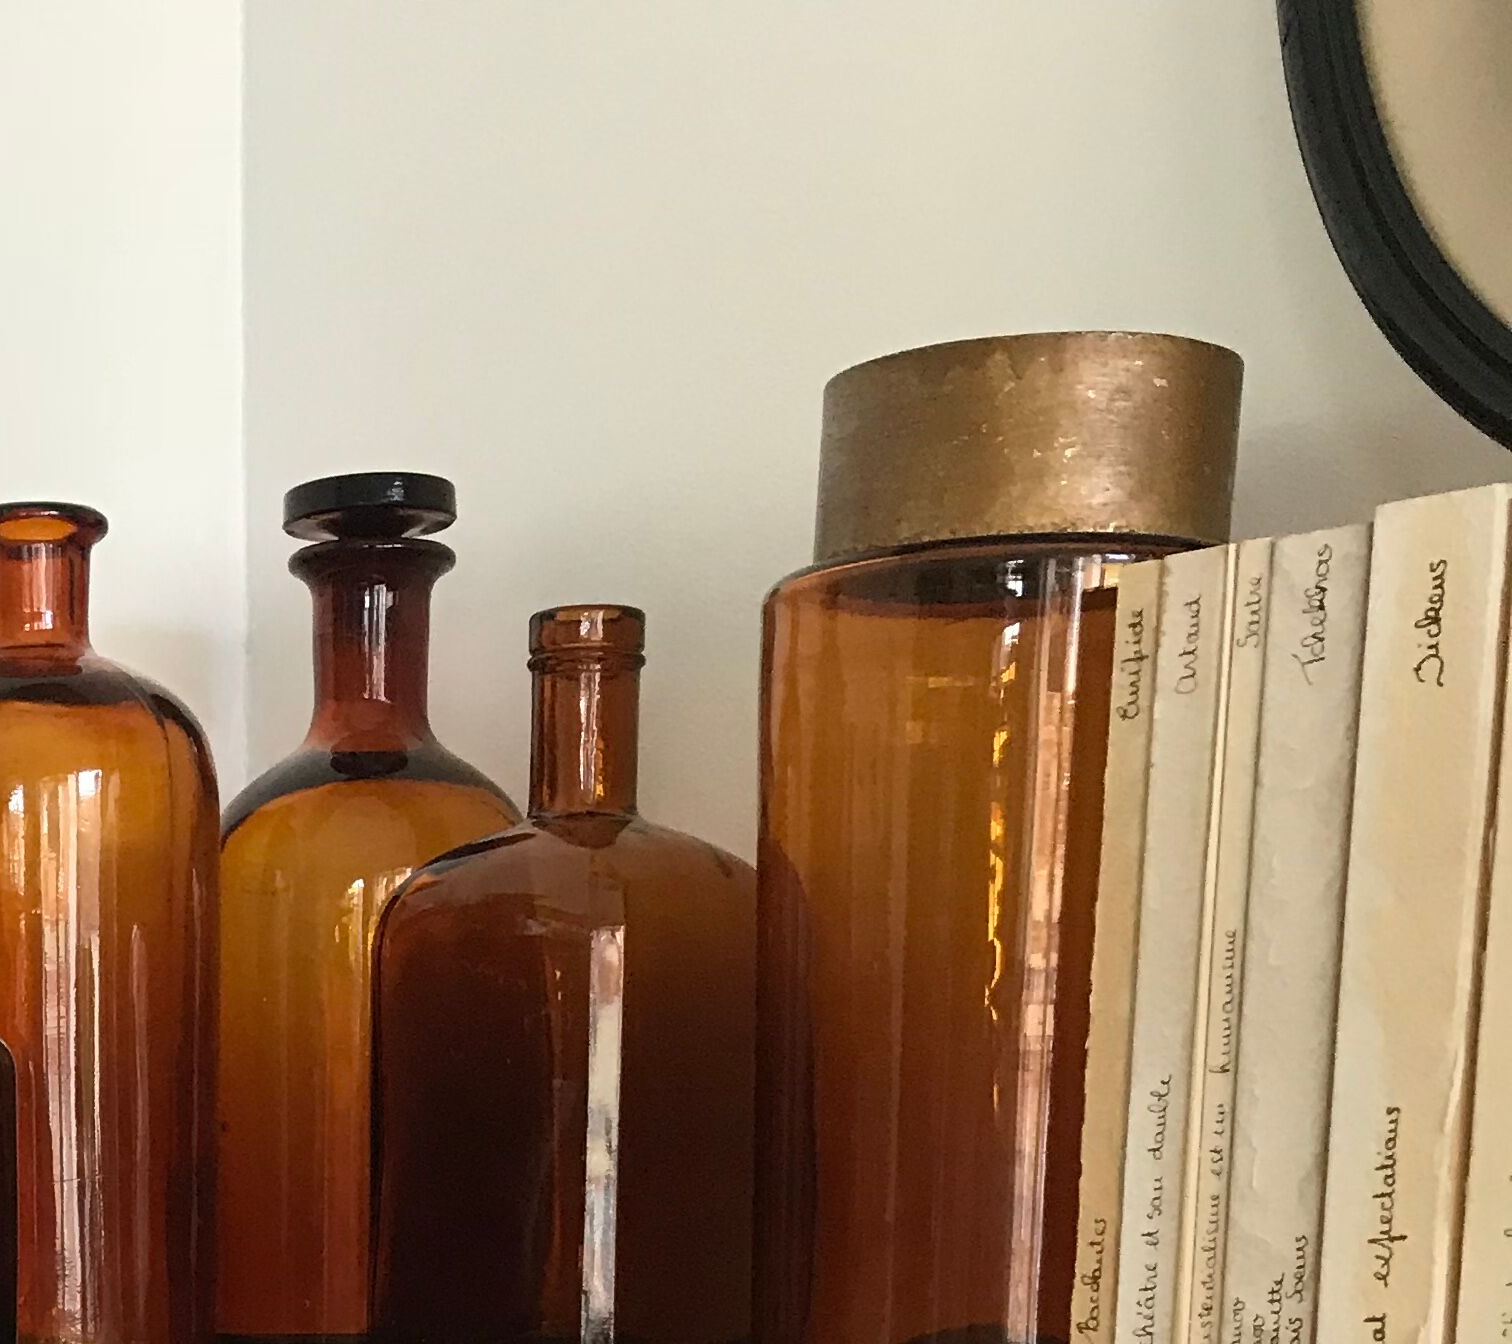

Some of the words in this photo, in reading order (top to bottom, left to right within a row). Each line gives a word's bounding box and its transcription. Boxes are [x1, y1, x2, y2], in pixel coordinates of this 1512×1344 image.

[1236, 574, 1263, 649] Sartre
[1413, 558, 1448, 688] Dickens
[1119, 607, 1145, 722] Euripide
[1208, 928, 1238, 1075] humanisme
[1144, 1073, 1174, 1163] double
[1214, 1102, 1227, 1141] un
[1148, 1174, 1164, 1222] son
[1208, 1146, 1225, 1180] est
[1367, 1105, 1403, 1285] expectations
[1143, 1227, 1163, 1251] et
